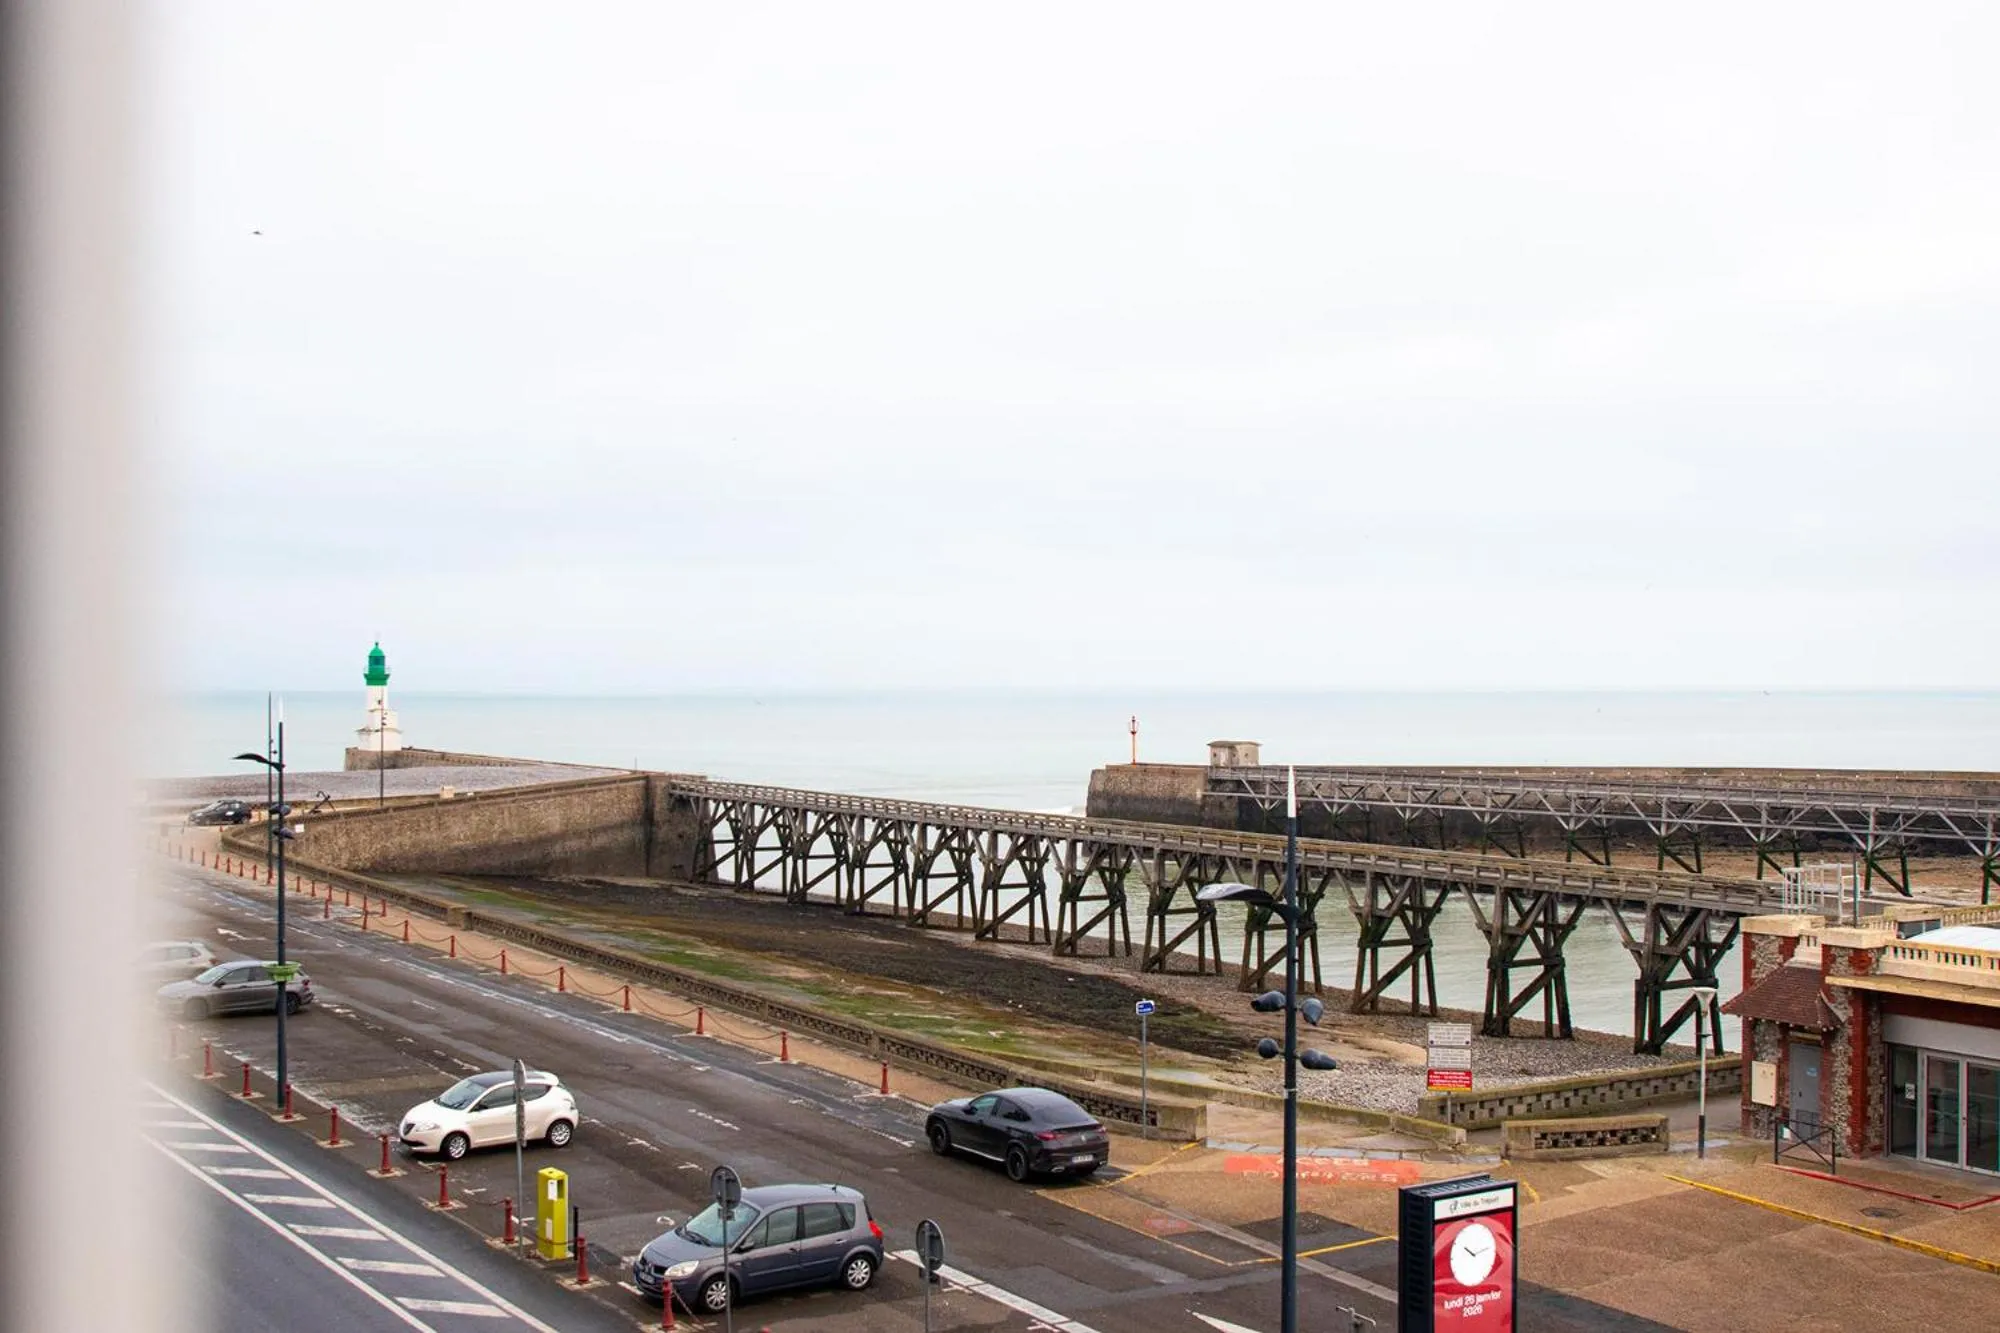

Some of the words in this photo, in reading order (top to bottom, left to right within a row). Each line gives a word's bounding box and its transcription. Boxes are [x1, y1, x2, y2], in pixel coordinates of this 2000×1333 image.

[1243, 1170, 1398, 1182] POPIERS
[1444, 1297, 1462, 1309] lundi
[1476, 1291, 1501, 1304] janvier
[1463, 1305, 1482, 1317] 2026
